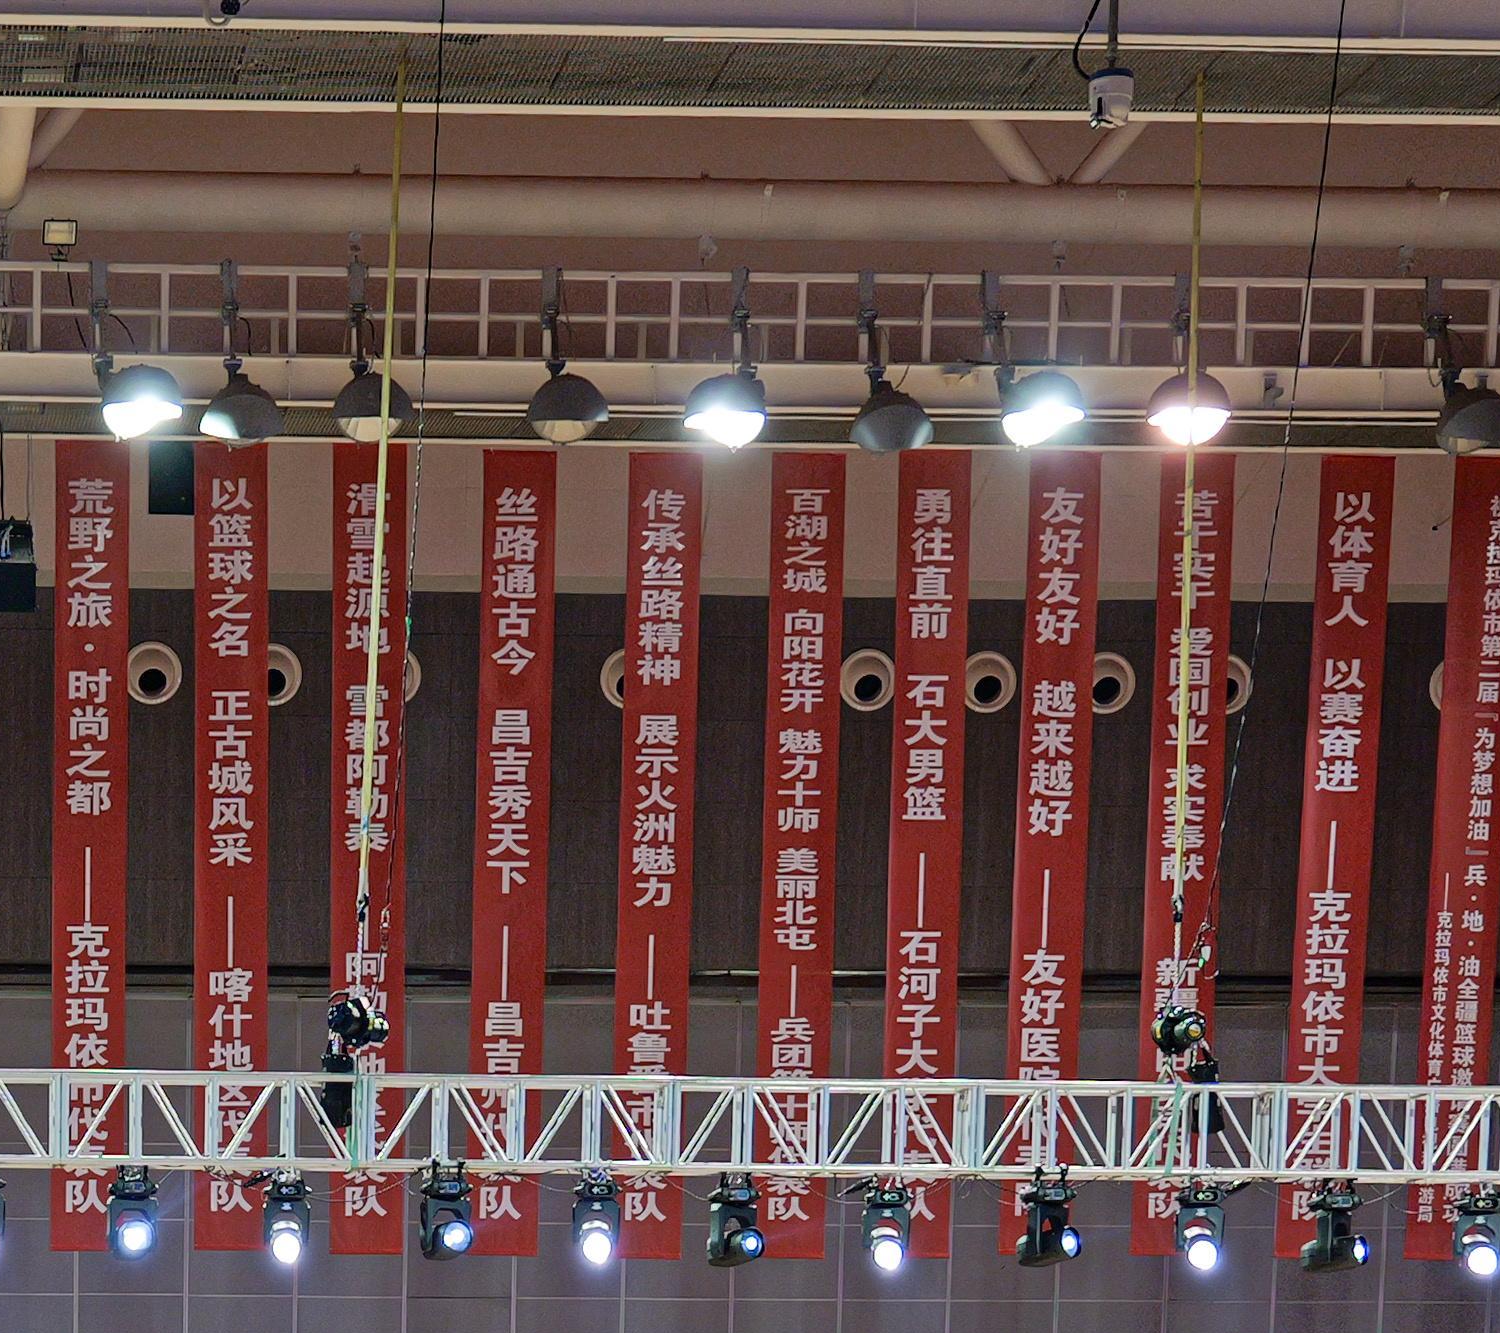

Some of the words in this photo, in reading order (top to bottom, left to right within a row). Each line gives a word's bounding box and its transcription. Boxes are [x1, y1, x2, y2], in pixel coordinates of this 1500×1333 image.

[208, 477, 253, 657] 以篮球之名
[345, 483, 390, 654] 滑雪起源地
[492, 487, 538, 675] 丝路通古今
[637, 489, 686, 685] 传承丝路精神
[783, 489, 830, 593] 百湖之城
[909, 489, 954, 639] 勇往直前
[1035, 488, 1084, 645] 友好友好
[1170, 491, 1219, 609] 苦干实干
[1324, 492, 1374, 627] 以体育人
[780, 609, 824, 712] 向阳花开
[1165, 628, 1213, 745] 爱国创业
[1314, 660, 1363, 792] 以赛奋进
[208, 691, 254, 867] 正古城风采
[344, 685, 390, 852] 雪都阿勒泰
[487, 709, 533, 894] 昌吉秀天下
[632, 714, 679, 908] 展示火洲魅力
[777, 729, 821, 832] 魅力十师
[902, 675, 949, 821] 石大男篮
[1028, 681, 1076, 837] 越来越好
[1161, 764, 1207, 882] 求实奉献
[773, 848, 819, 951] 美丽北屯
